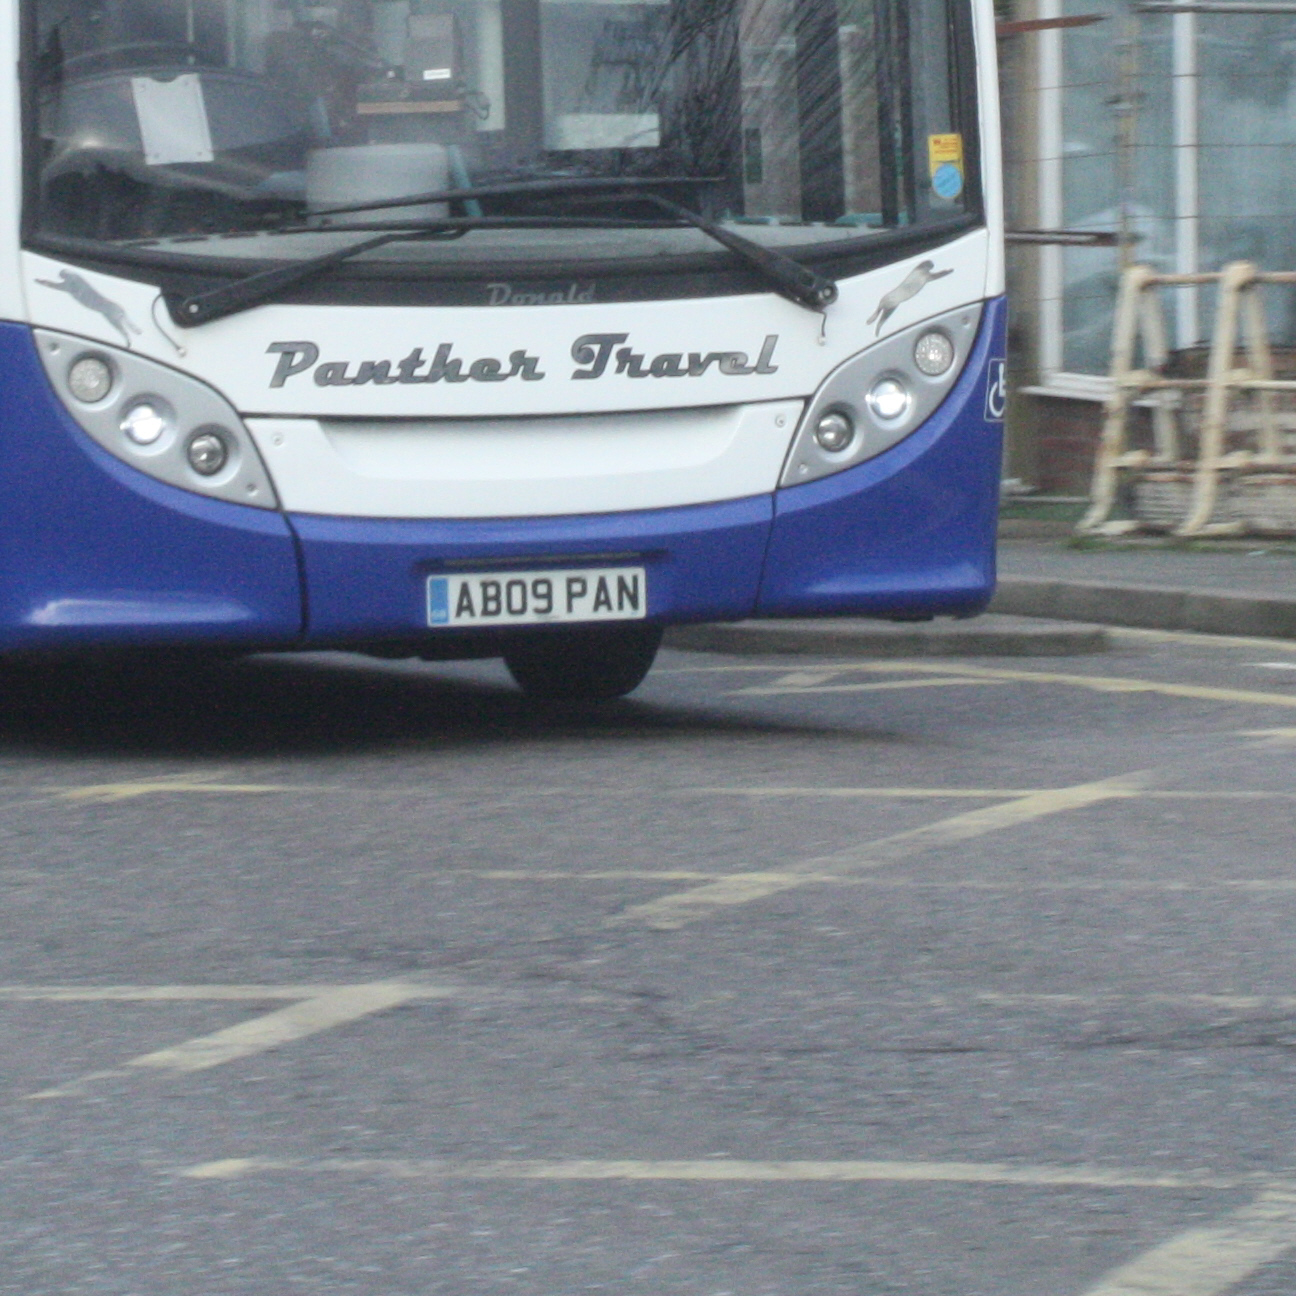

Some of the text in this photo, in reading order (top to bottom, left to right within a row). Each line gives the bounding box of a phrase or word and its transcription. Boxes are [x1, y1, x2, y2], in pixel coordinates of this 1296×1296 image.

[487, 282, 596, 306] Donald
[266, 332, 779, 389] Panther Travel
[455, 574, 639, 619] AB09 PAN
